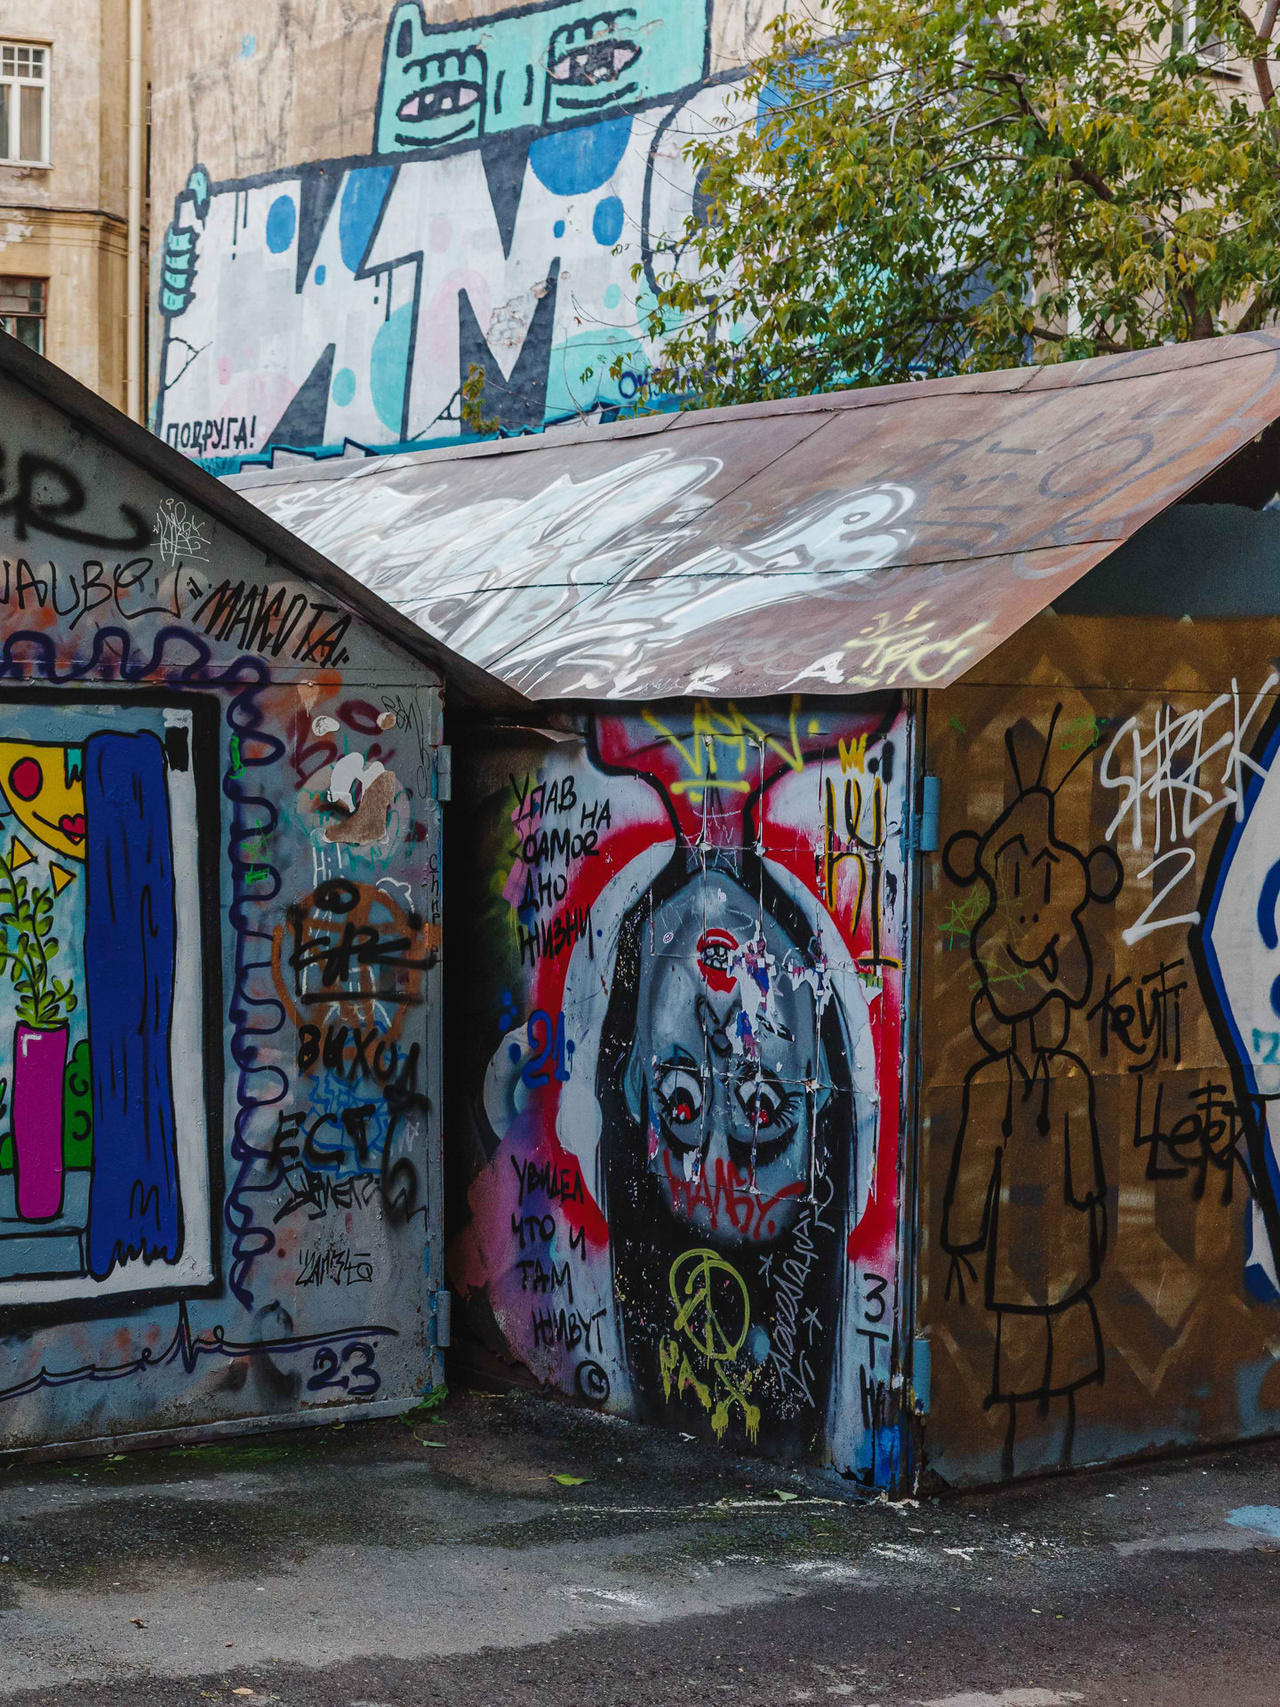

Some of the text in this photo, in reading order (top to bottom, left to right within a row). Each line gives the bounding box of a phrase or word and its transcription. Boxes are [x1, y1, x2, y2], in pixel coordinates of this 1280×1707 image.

[166, 415, 257, 458] ПОДРУГА!
[509, 772, 611, 829] УПАВ НА
[518, 868, 568, 912] ДНО
[1121, 847, 1202, 946] 2
[518, 903, 595, 968] ЖИЗНИ
[510, 1153, 584, 1206] УВИДЕЛ
[510, 1212, 586, 1260] ЧТО И
[515, 1260, 574, 1305] ТАМ
[531, 1307, 607, 1353] ЖИВУТ
[306, 1341, 382, 1396] 23
